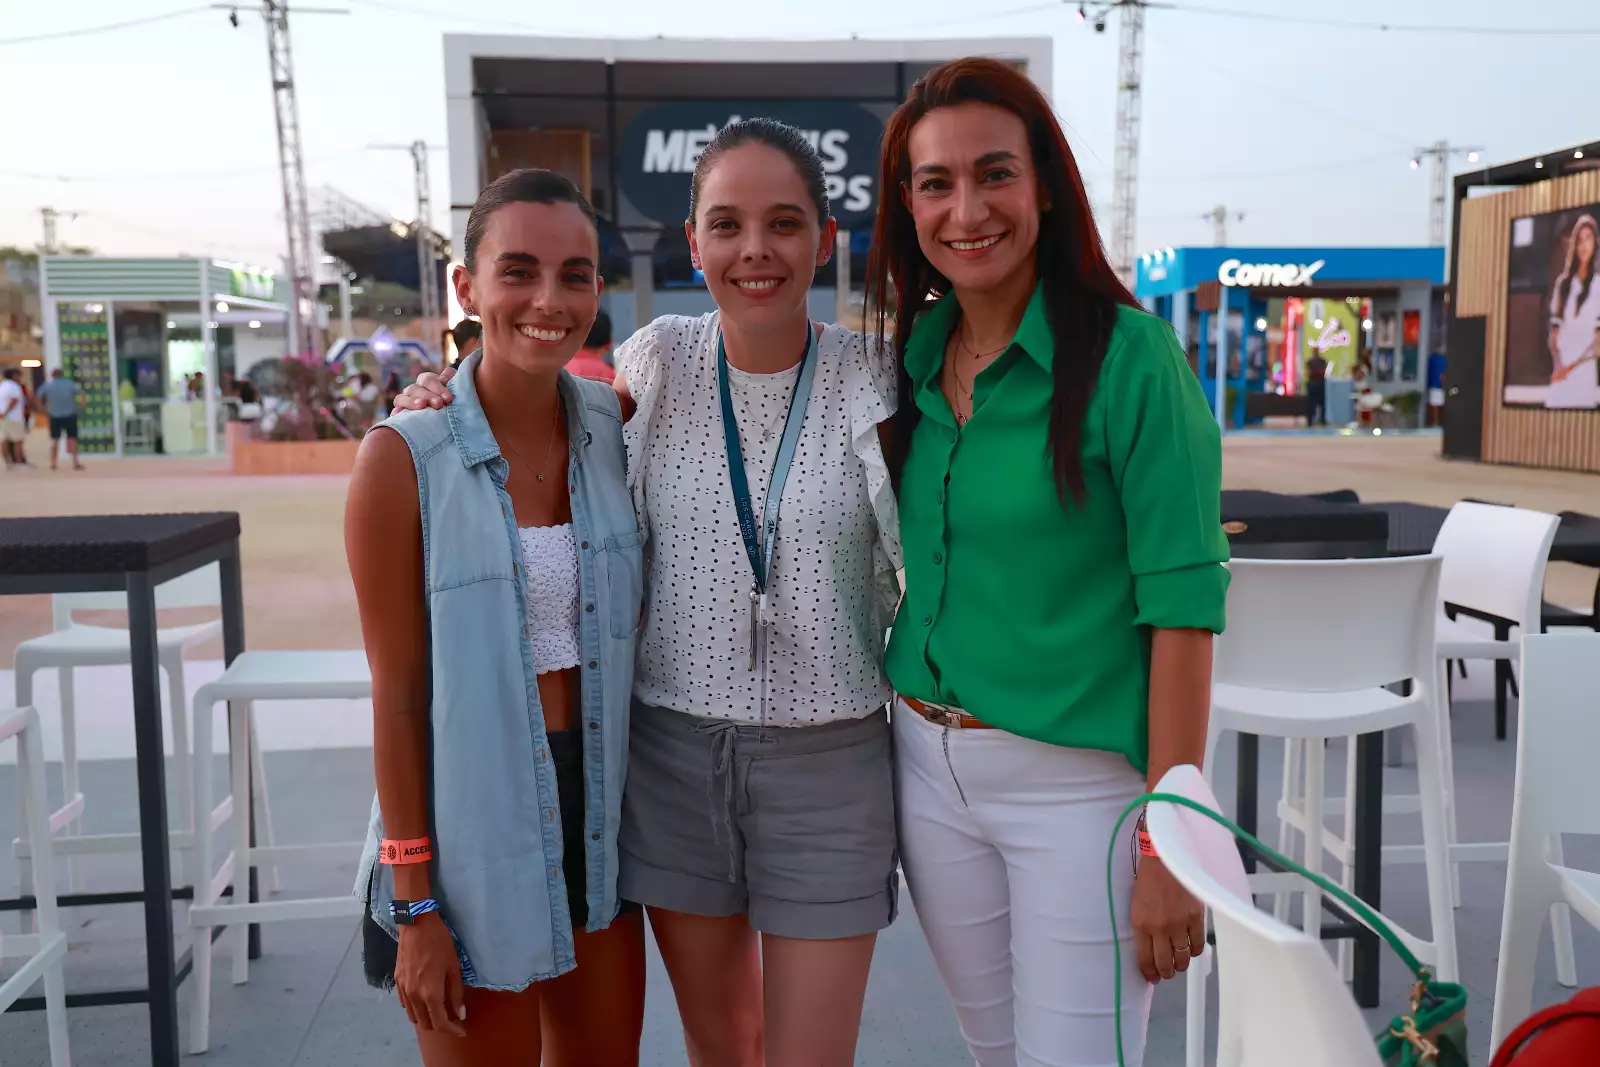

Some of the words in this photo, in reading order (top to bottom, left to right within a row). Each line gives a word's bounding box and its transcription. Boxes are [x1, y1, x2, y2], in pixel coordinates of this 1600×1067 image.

[1218, 258, 1326, 287] Comex
[741, 497, 749, 512] LOS
[767, 520, 775, 535] WE
